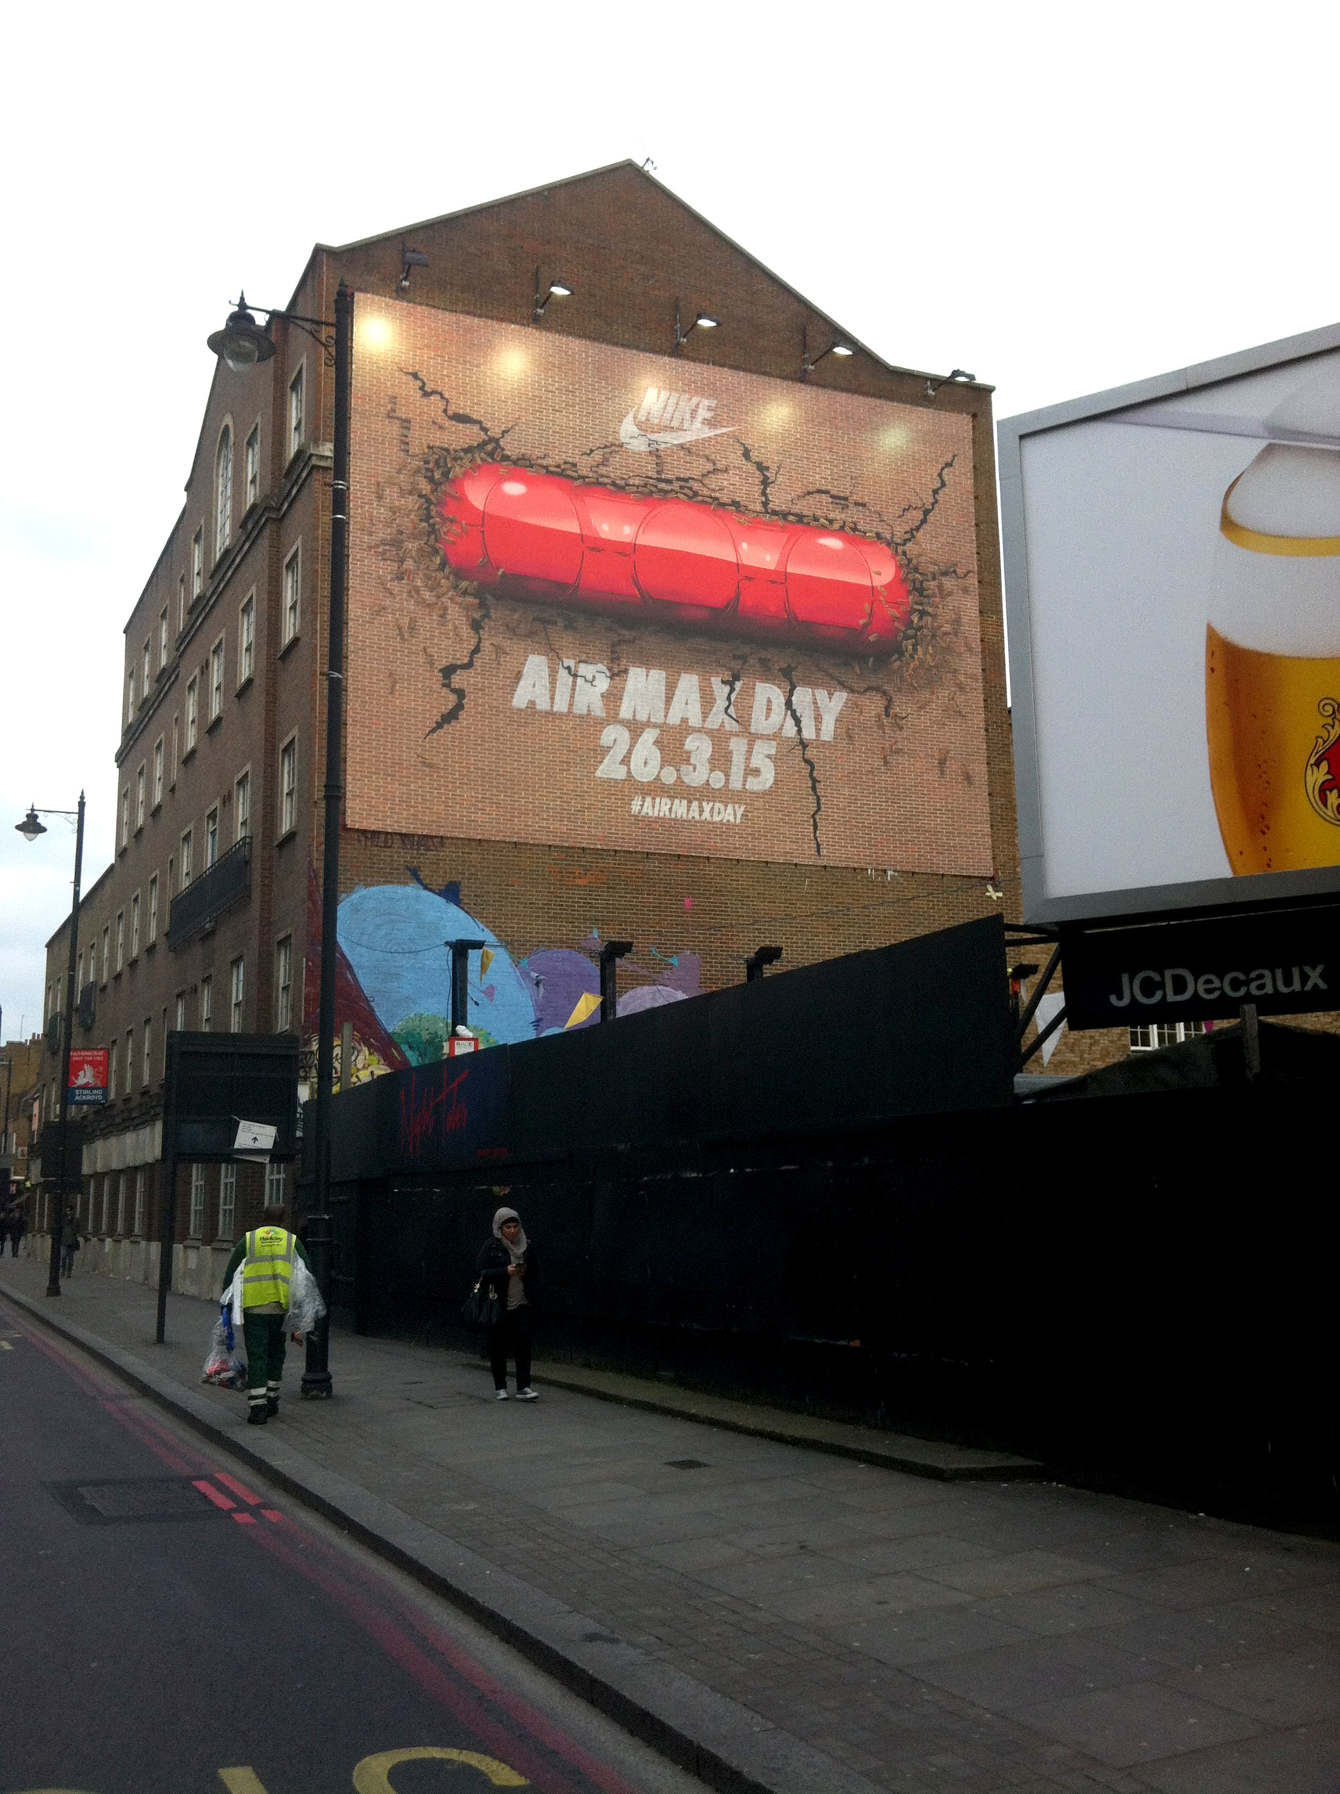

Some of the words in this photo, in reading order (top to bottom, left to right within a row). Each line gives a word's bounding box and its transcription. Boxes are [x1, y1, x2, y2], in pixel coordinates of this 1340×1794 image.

[637, 386, 718, 432] NIKE
[511, 654, 609, 717] AIR
[619, 666, 743, 731] MAX
[751, 682, 848, 742] DAY
[595, 723, 777, 792] 26.3.15
[630, 796, 746, 824] #AIRMAXDAY
[1109, 964, 1328, 1007] JCDecaux
